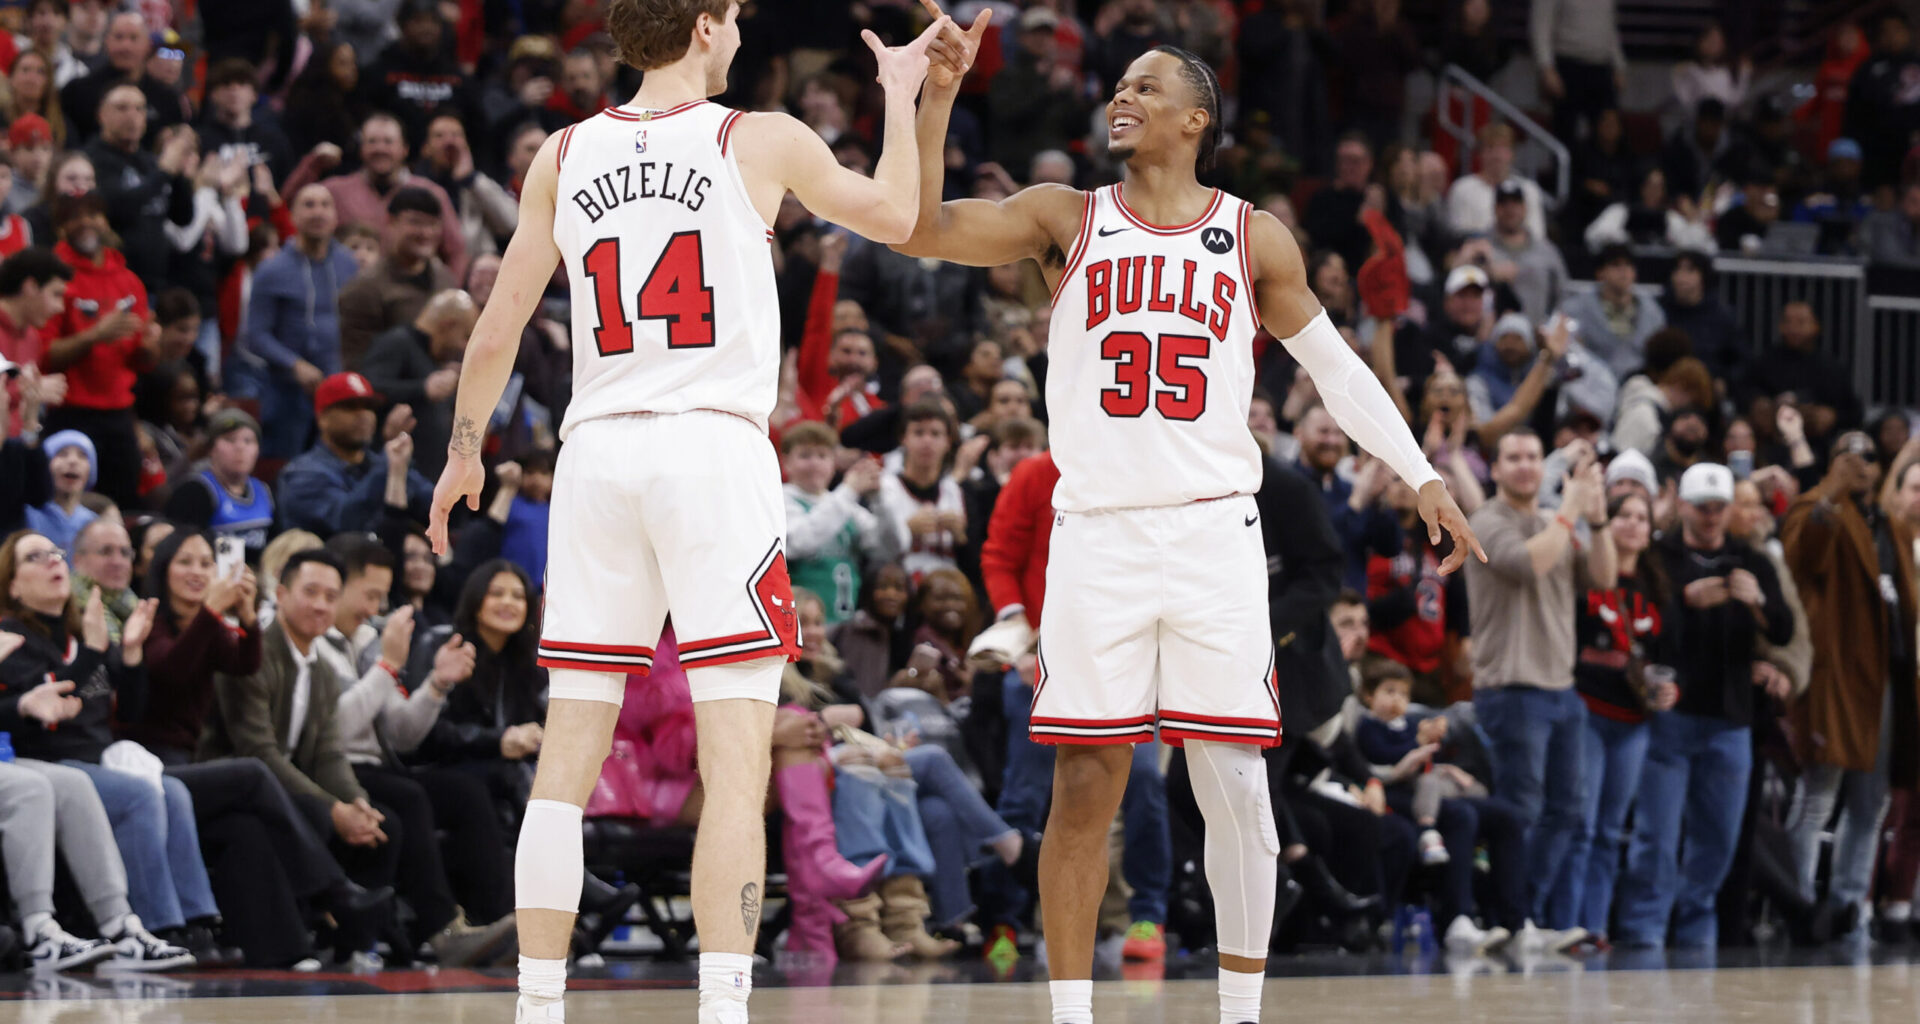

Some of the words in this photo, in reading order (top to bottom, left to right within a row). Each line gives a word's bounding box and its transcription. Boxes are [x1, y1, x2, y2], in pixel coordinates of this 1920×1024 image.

[572, 162, 712, 223] BUZELIS
[583, 230, 715, 357] 14
[1086, 255, 1236, 343] BULLS
[1100, 331, 1210, 422] 35
